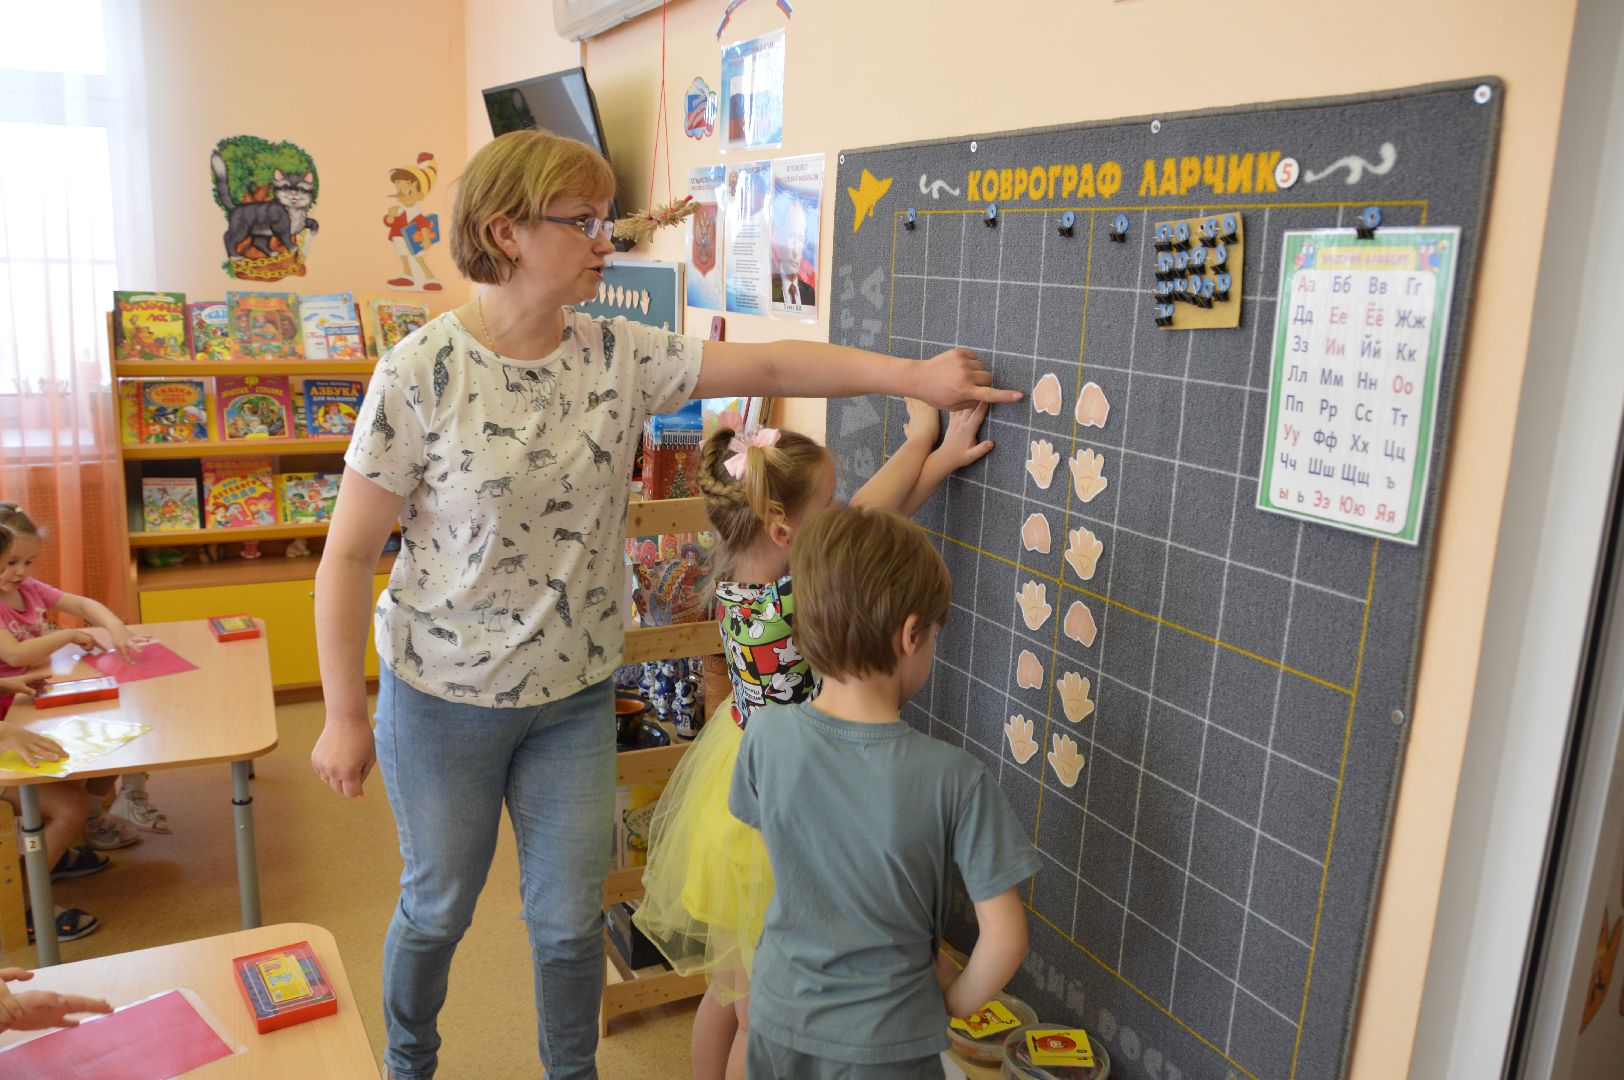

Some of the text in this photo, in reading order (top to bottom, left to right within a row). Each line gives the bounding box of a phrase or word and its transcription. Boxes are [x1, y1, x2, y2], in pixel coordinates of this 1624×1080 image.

[967, 150, 1281, 202] КОВРОГРАФ ЛАРЧИК
[1280, 161, 1294, 184] 5
[1297, 275, 1422, 296] Аа Бб Вв Гг
[1293, 302, 1426, 329] Дд Ее Ёё Жж
[1292, 334, 1417, 362] Зз Ии Йй Кк
[310, 385, 360, 396] АЗБУКА
[1288, 365, 1413, 394] Лл Мм Нн Оо
[1285, 395, 1408, 427] Пп Рр Сс Тт
[1284, 424, 1406, 462] Уу Фф Хх Цц
[1280, 452, 1297, 470] Чч
[1308, 457, 1335, 478] Шш
[1341, 464, 1370, 487] Щщ
[1313, 490, 1330, 509] Ээ
[1339, 495, 1365, 517] Юю
[1375, 504, 1396, 523] Яя
